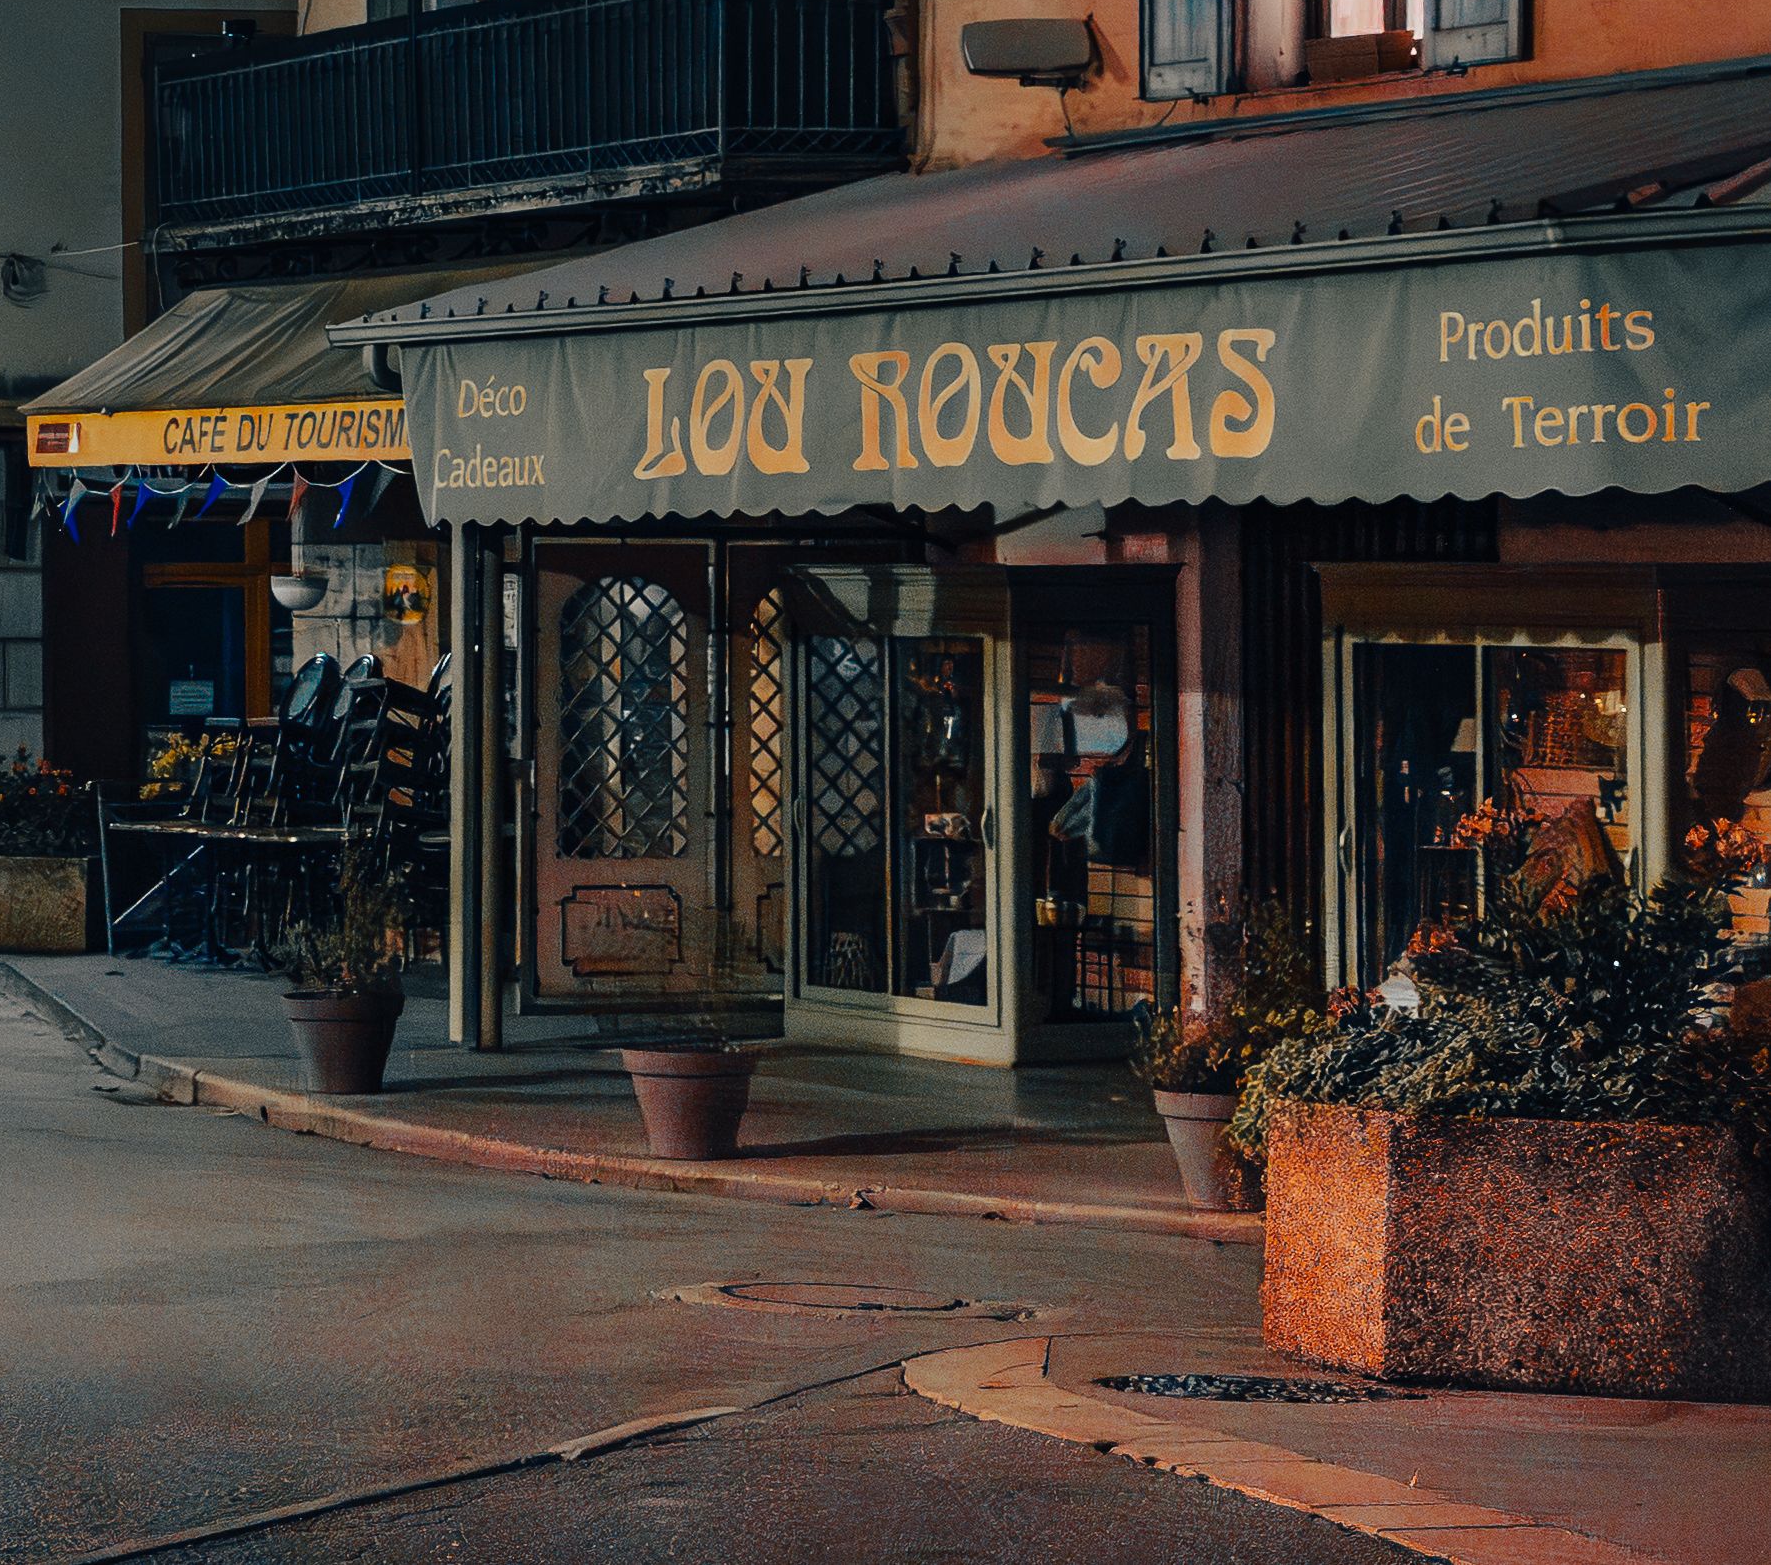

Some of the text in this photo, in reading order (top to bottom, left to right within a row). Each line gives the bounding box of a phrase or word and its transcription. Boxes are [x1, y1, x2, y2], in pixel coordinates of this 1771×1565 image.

[1439, 298, 1656, 363] Produits
[457, 374, 527, 420] Déco
[633, 327, 1278, 481] LOU ROUCAS
[1414, 387, 1711, 456] de Terroir
[163, 405, 408, 454] CAFÉ DU TOURISM
[433, 444, 546, 490] Cadeaux
